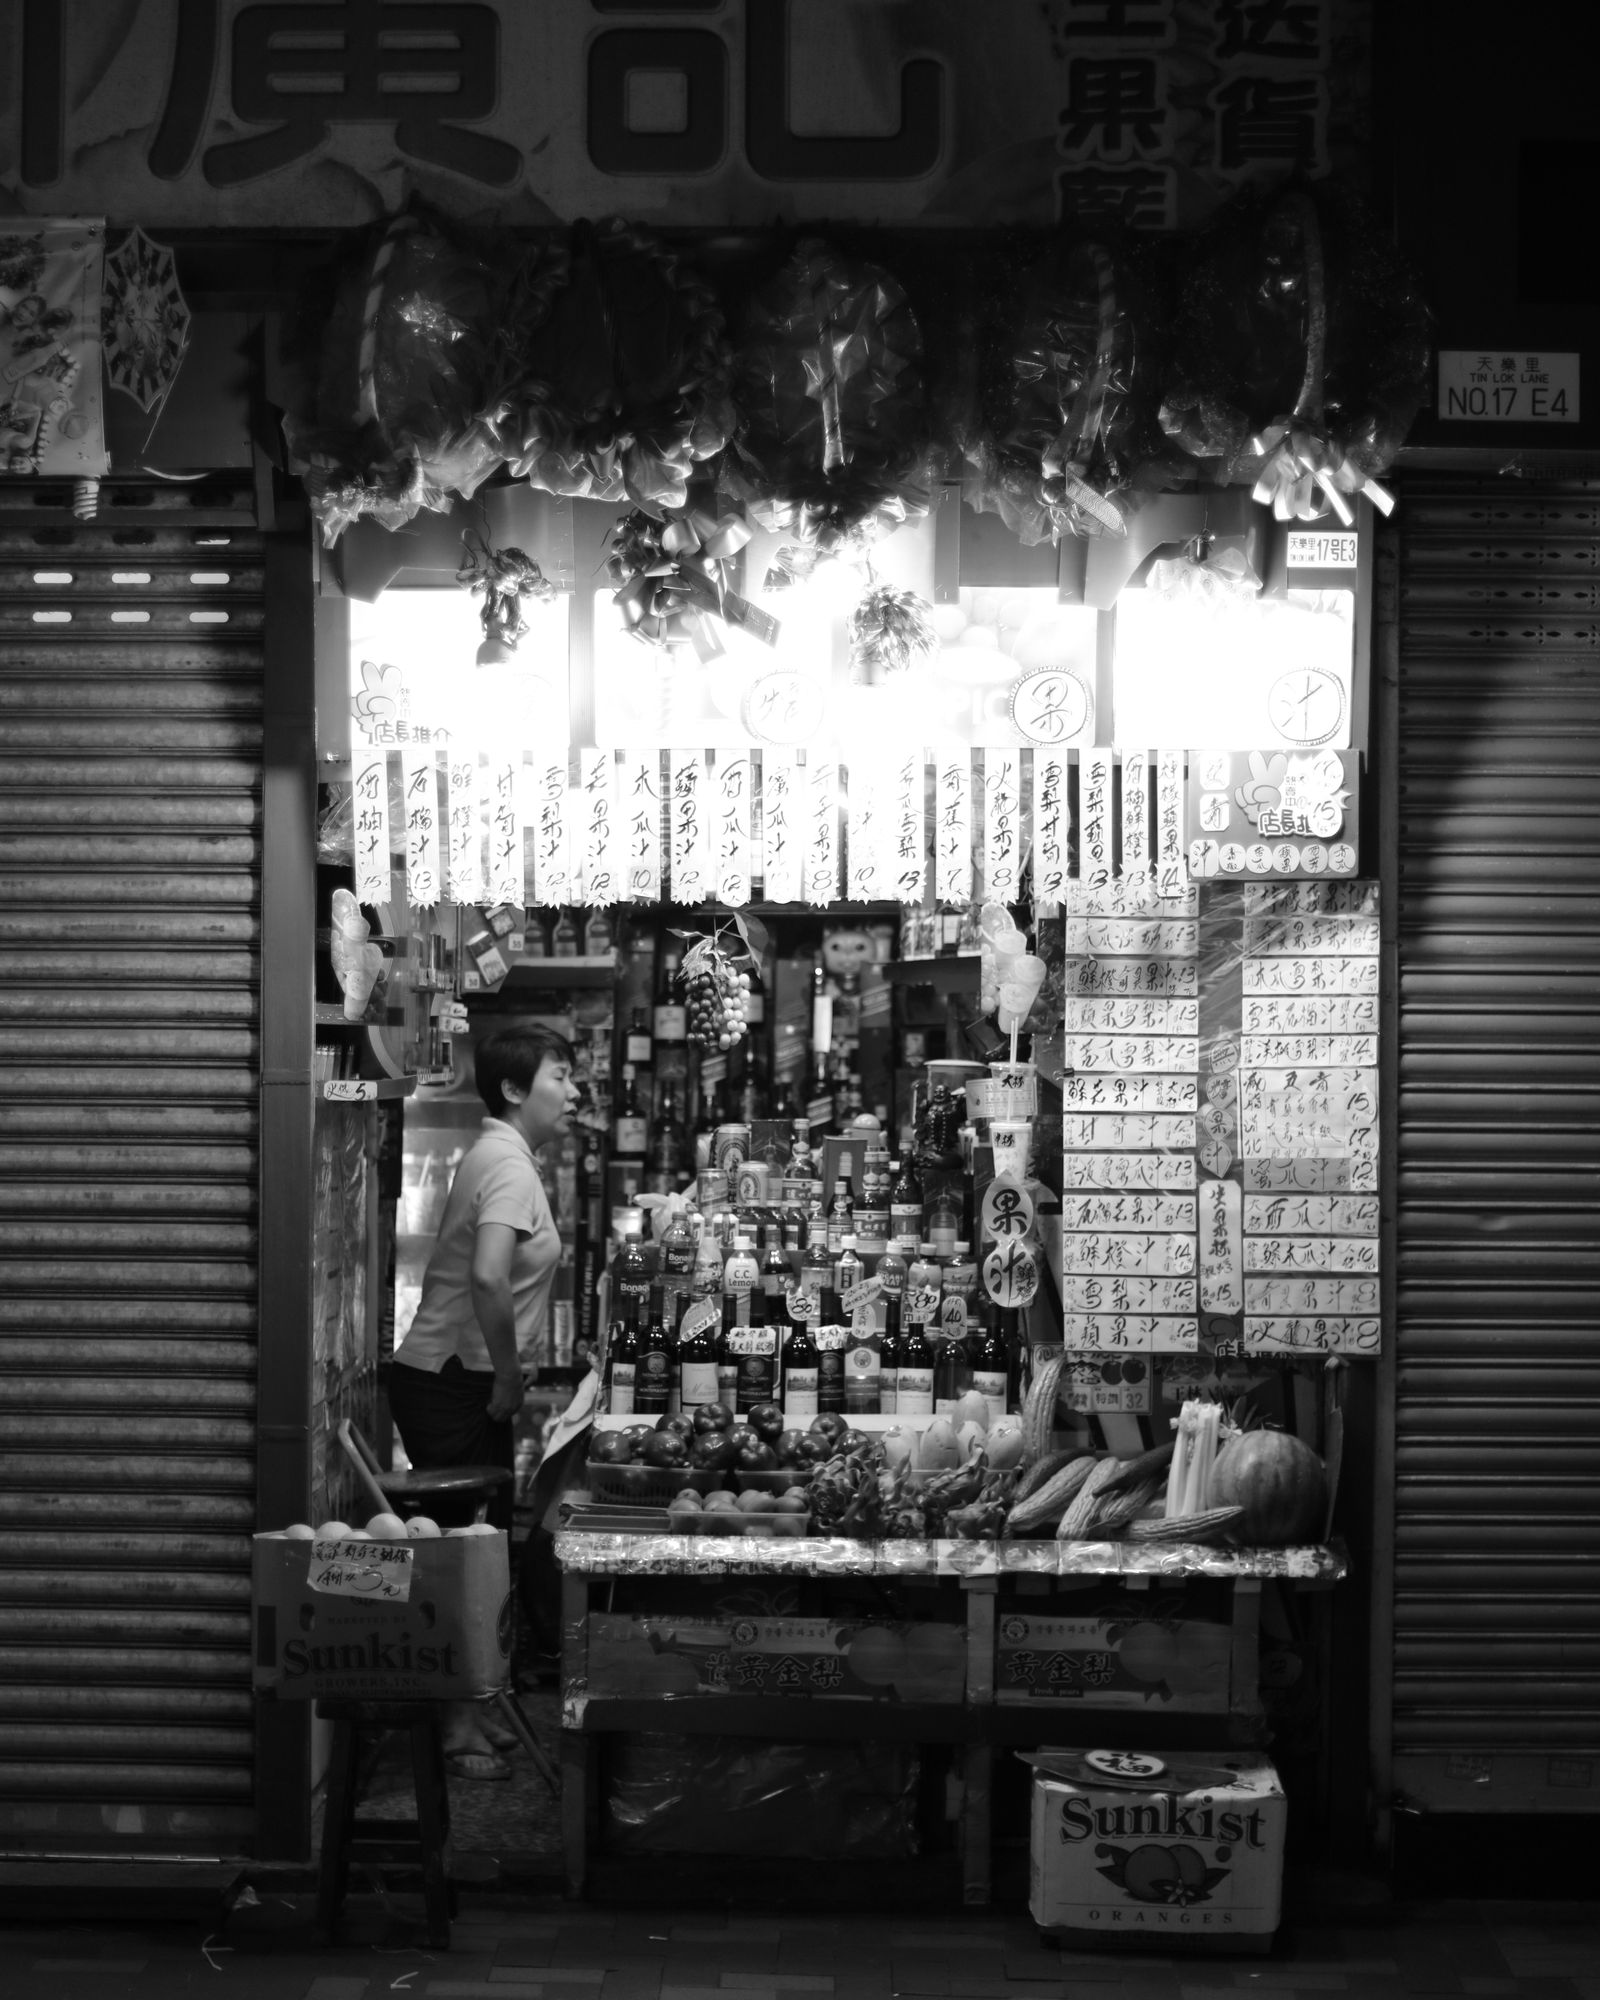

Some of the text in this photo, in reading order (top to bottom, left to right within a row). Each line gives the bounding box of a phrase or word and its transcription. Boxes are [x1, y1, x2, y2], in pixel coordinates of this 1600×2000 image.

[22, 0, 946, 190] 廣記
[1477, 356, 1541, 373] 天樂里
[1470, 373, 1549, 384] TIN LOK LANE
[1531, 387, 1569, 417] E4
[1290, 538, 1316, 550] 天樂里
[373, 720, 453, 746] 店長推介
[1313, 799, 1336, 821] 15
[407, 764, 433, 890] 石榴汁 13
[539, 765, 568, 888] 雪梨汁 12
[630, 764, 662, 889] 木瓜汁 10
[938, 763, 970, 891] 香蕉汁 7
[589, 871, 611, 892] 12
[678, 871, 700, 886] 12
[812, 869, 833, 891] 8
[854, 865, 877, 882] 10
[991, 867, 1013, 888] 8
[1042, 871, 1063, 893] 13
[1088, 868, 1109, 891] 13
[1126, 870, 1146, 887] 13
[1160, 866, 1180, 888] 14
[499, 877, 518, 893] 12
[722, 873, 742, 894] 12
[1180, 966, 1196, 984] 13
[1359, 965, 1378, 984] 13
[1179, 1004, 1198, 1021] 13
[1353, 1001, 1374, 1019] 13
[1175, 1043, 1197, 1060] 13
[1353, 1038, 1372, 1058] 14
[1001, 1073, 1025, 1090] 大杯
[355, 1082, 367, 1101] 5
[1178, 1084, 1197, 1101] 12
[1347, 1093, 1370, 1110] 15
[1175, 1160, 1193, 1177] 13
[1351, 1161, 1373, 1184] 12
[1176, 1202, 1194, 1220] 13
[1356, 1202, 1379, 1219] 12
[989, 1188, 1029, 1308] 果汁
[1079, 1235, 1155, 1273] 鮮橙汁
[1174, 1243, 1193, 1260] 14
[1357, 1246, 1374, 1264] 10
[728, 1278, 756, 1288] Lemon
[734, 1269, 753, 1280] C.C.
[915, 1293, 937, 1310] 80
[1077, 1278, 1158, 1310] 雪梨汁
[1173, 1280, 1194, 1299] 12
[1216, 1283, 1232, 1302] 15
[1357, 1282, 1376, 1304] 8
[945, 1308, 962, 1324] 40
[1080, 1315, 1197, 1351] 蘋果汁 12
[1356, 1320, 1379, 1349] 8
[1126, 1393, 1144, 1410] 32
[285, 1631, 462, 1678] Sunkist
[736, 1654, 846, 1689] 黃金梨
[1006, 1651, 1116, 1687] 黃金梨
[1061, 1791, 1267, 1848] Sunkist
[1089, 1909, 1233, 1925] ORANGES
